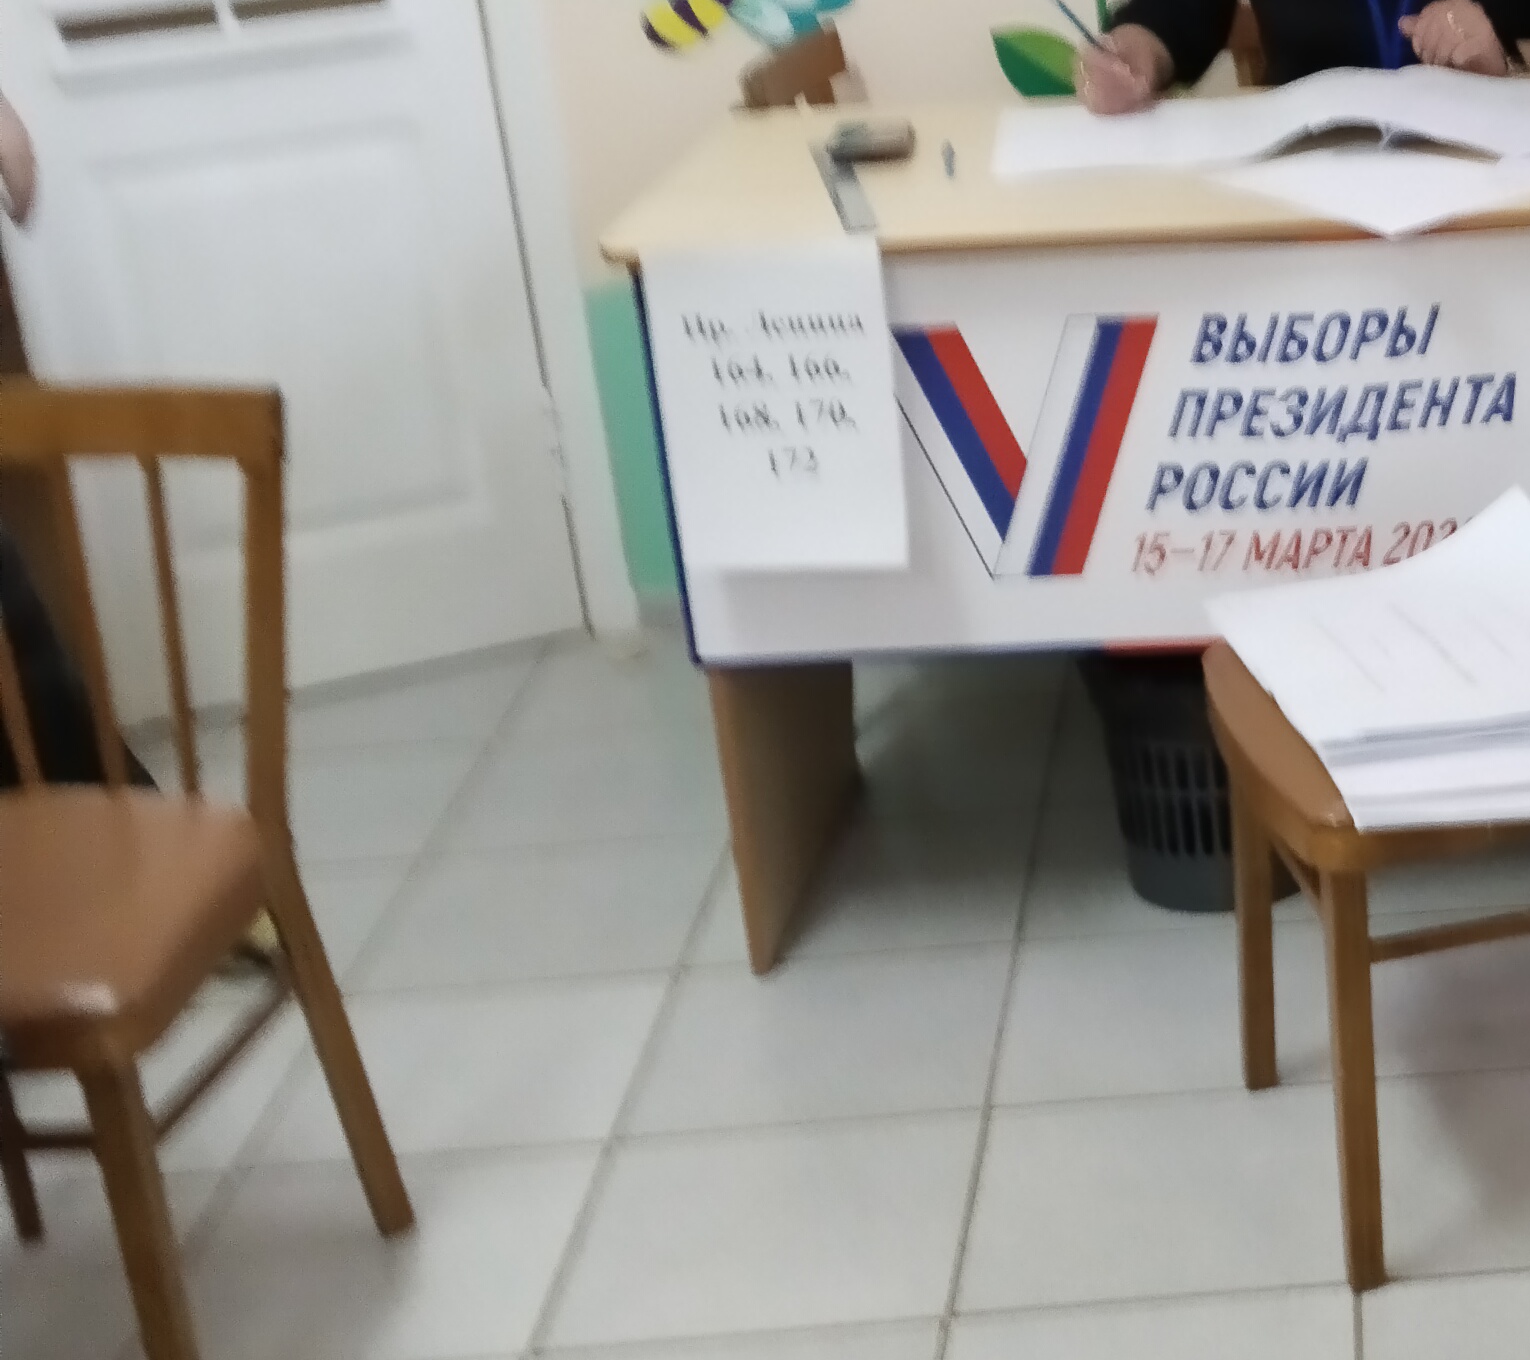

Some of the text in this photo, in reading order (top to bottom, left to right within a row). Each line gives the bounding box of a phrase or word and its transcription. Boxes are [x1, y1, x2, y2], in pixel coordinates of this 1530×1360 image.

[1190, 302, 1441, 364] ВЫБОРЫ
[1168, 371, 1517, 442] ПРЕЗИДЕНТА
[1146, 457, 1369, 512] РОССИИ
[1242, 525, 1374, 572] МАРТА
[1381, 516, 1474, 567] 202
